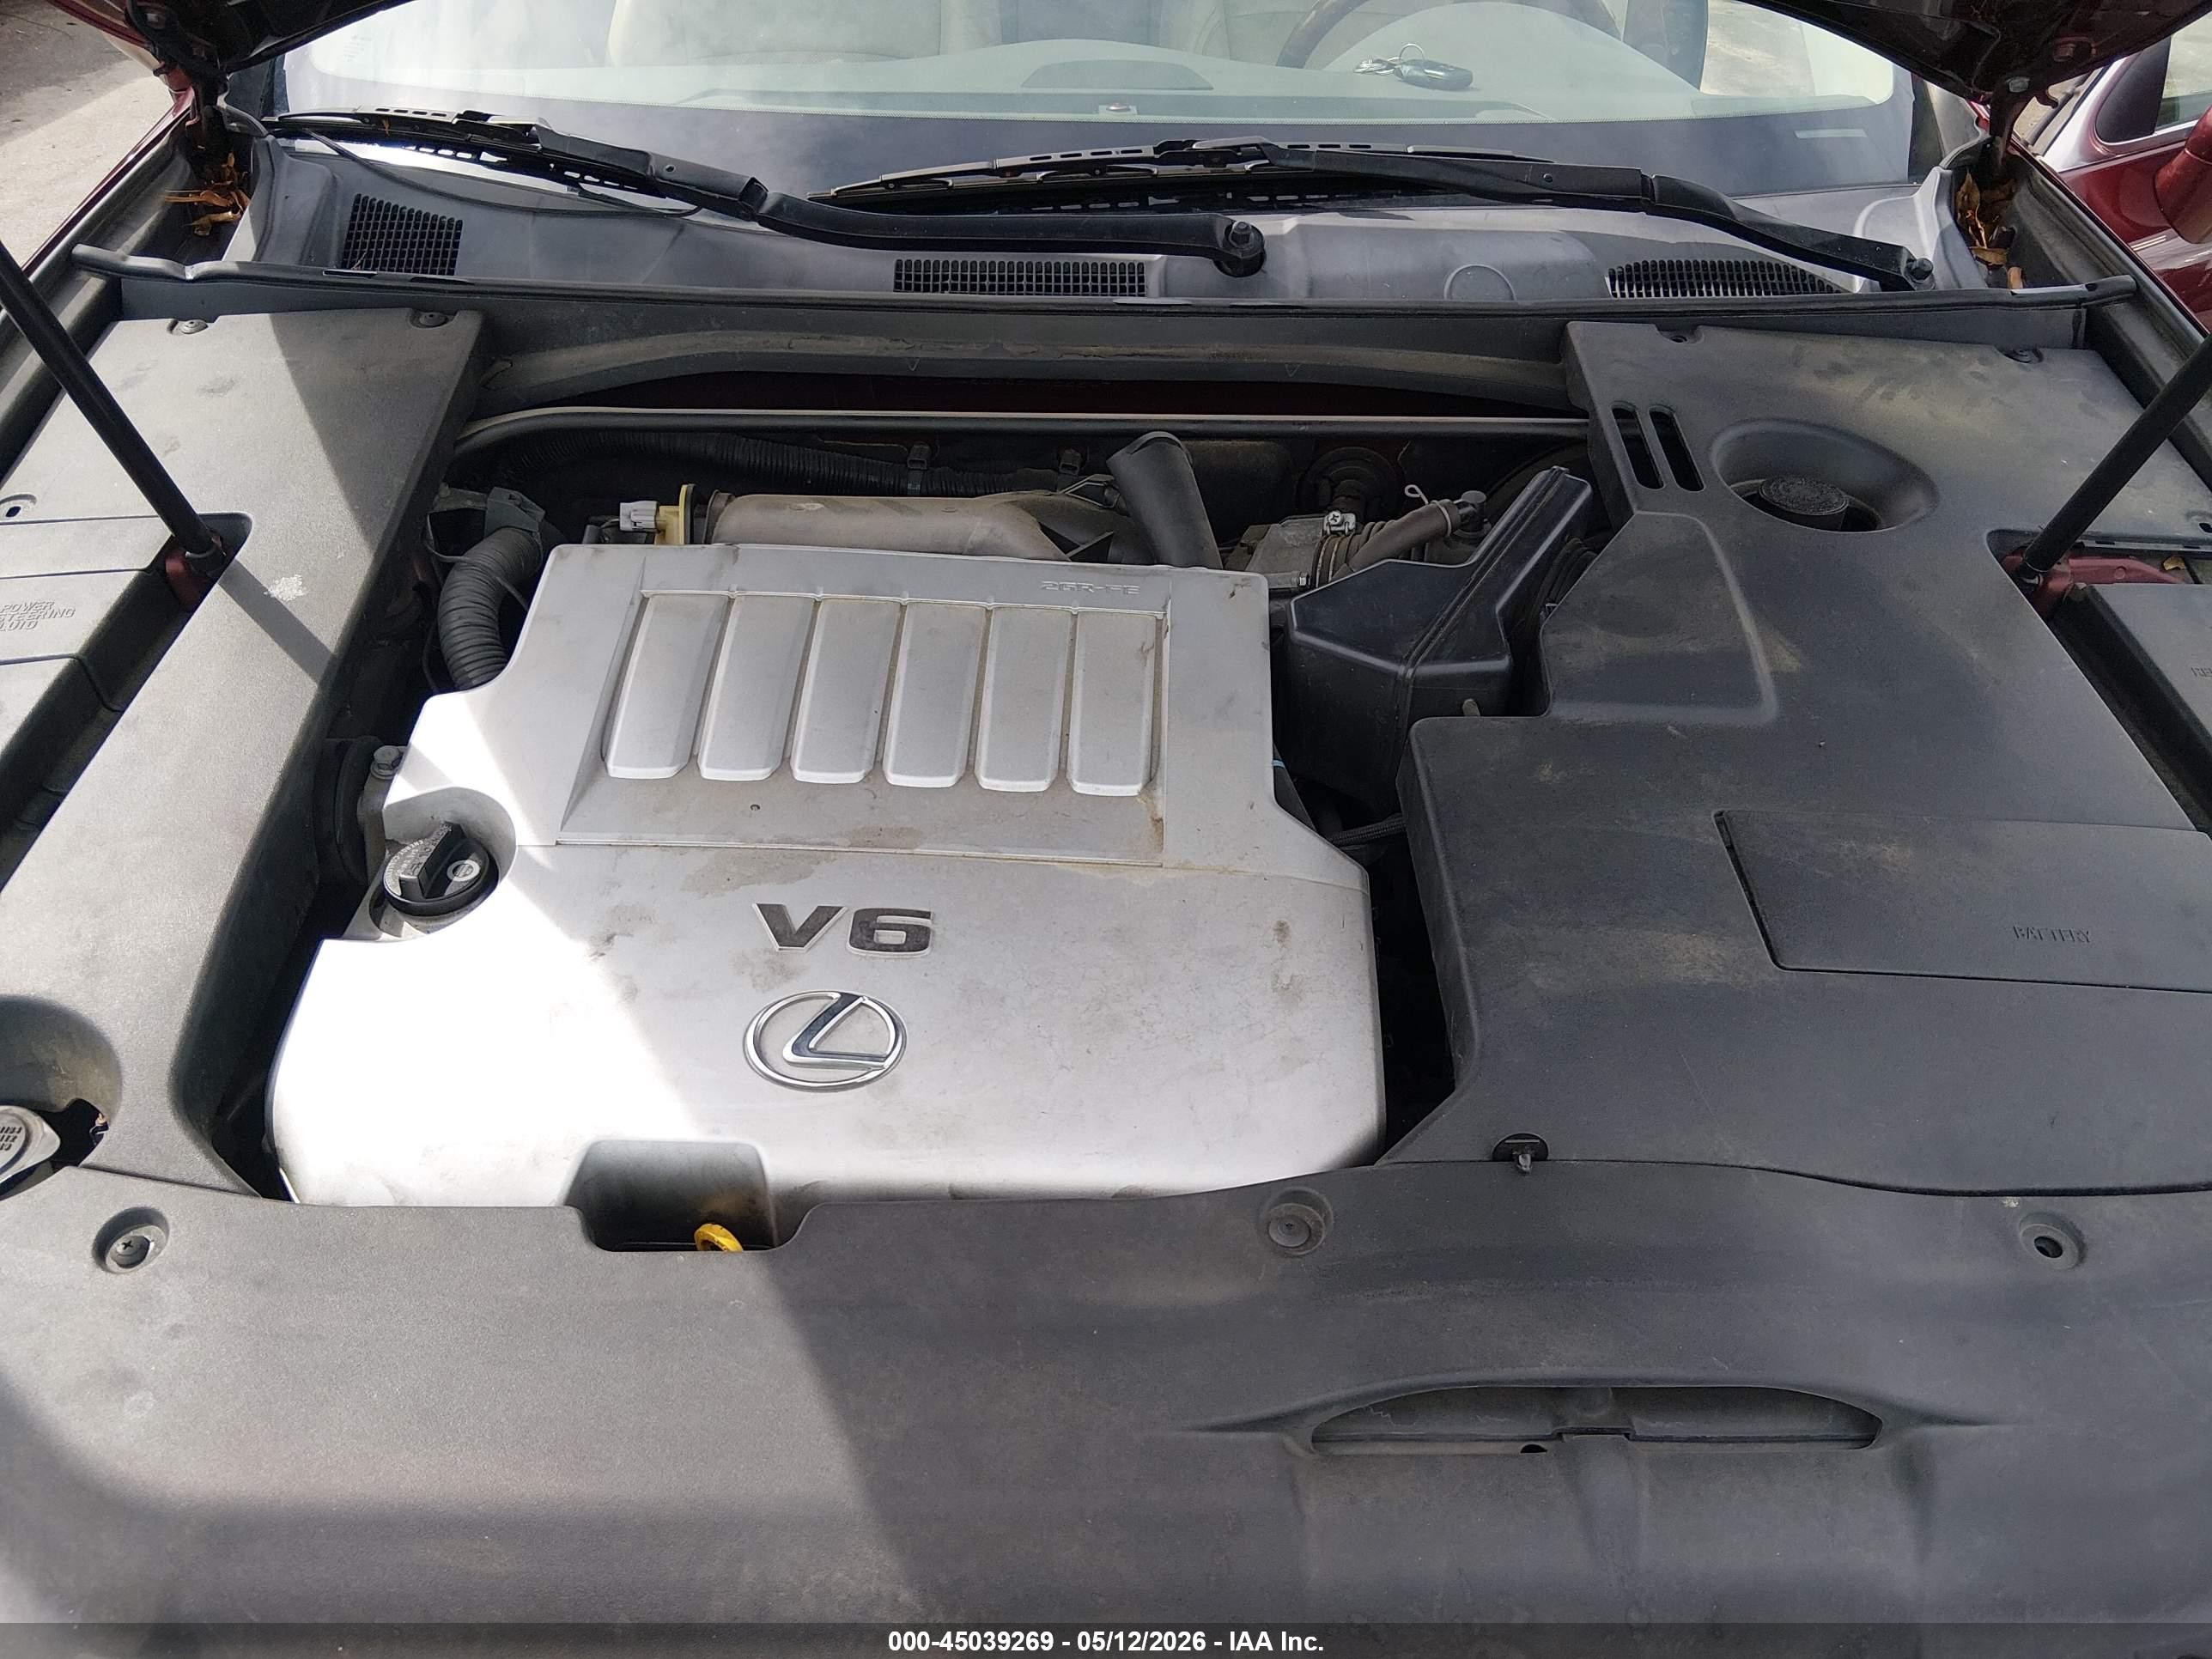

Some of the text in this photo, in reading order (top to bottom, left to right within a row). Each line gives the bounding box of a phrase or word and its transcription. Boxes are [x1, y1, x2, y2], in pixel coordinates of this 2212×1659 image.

[0, 601, 55, 614] POWER
[0, 620, 39, 631] LUID
[752, 902, 934, 958] V6
[2013, 926, 2090, 944] BATTERY
